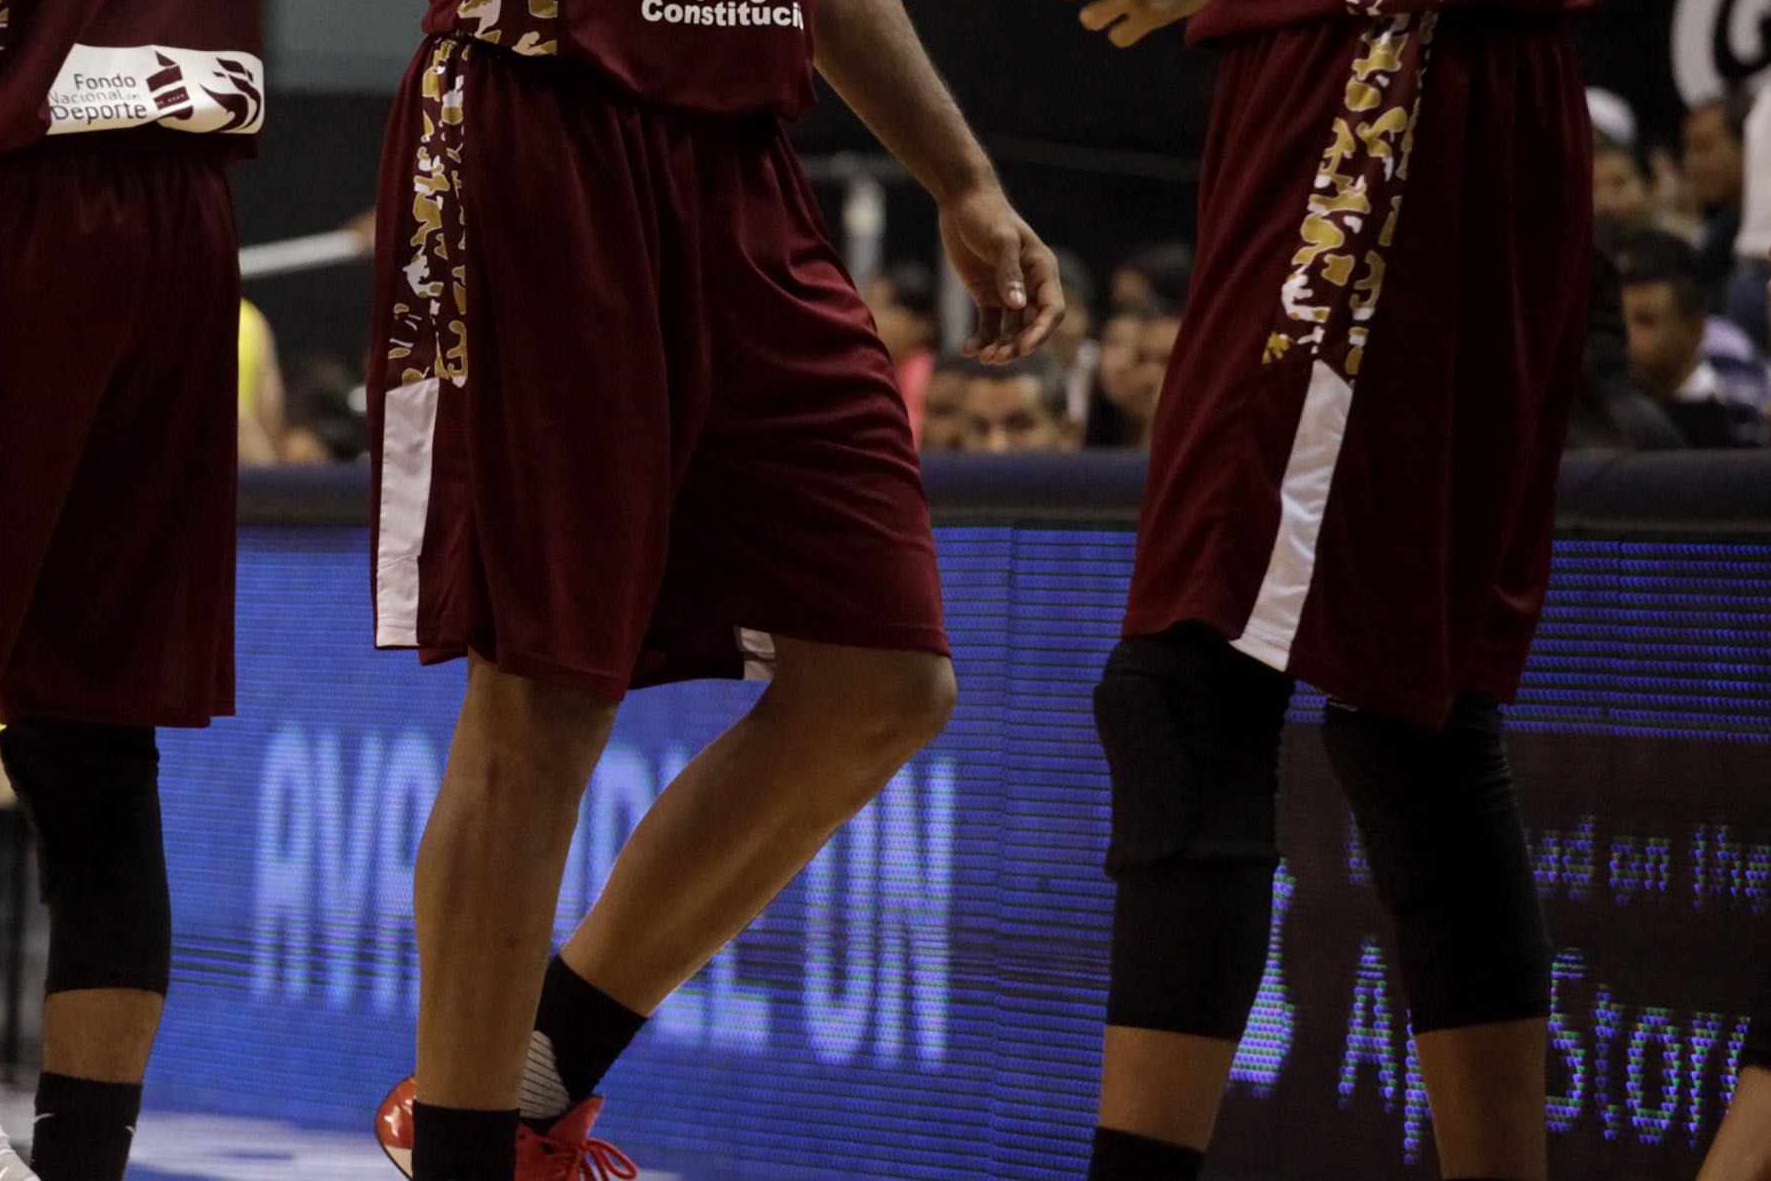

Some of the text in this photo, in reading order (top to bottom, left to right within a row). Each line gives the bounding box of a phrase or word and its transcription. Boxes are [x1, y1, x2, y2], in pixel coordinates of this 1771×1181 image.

[73, 73, 137, 90] Fondo
[48, 88, 123, 106] Nacional
[50, 100, 148, 125] Deporte
